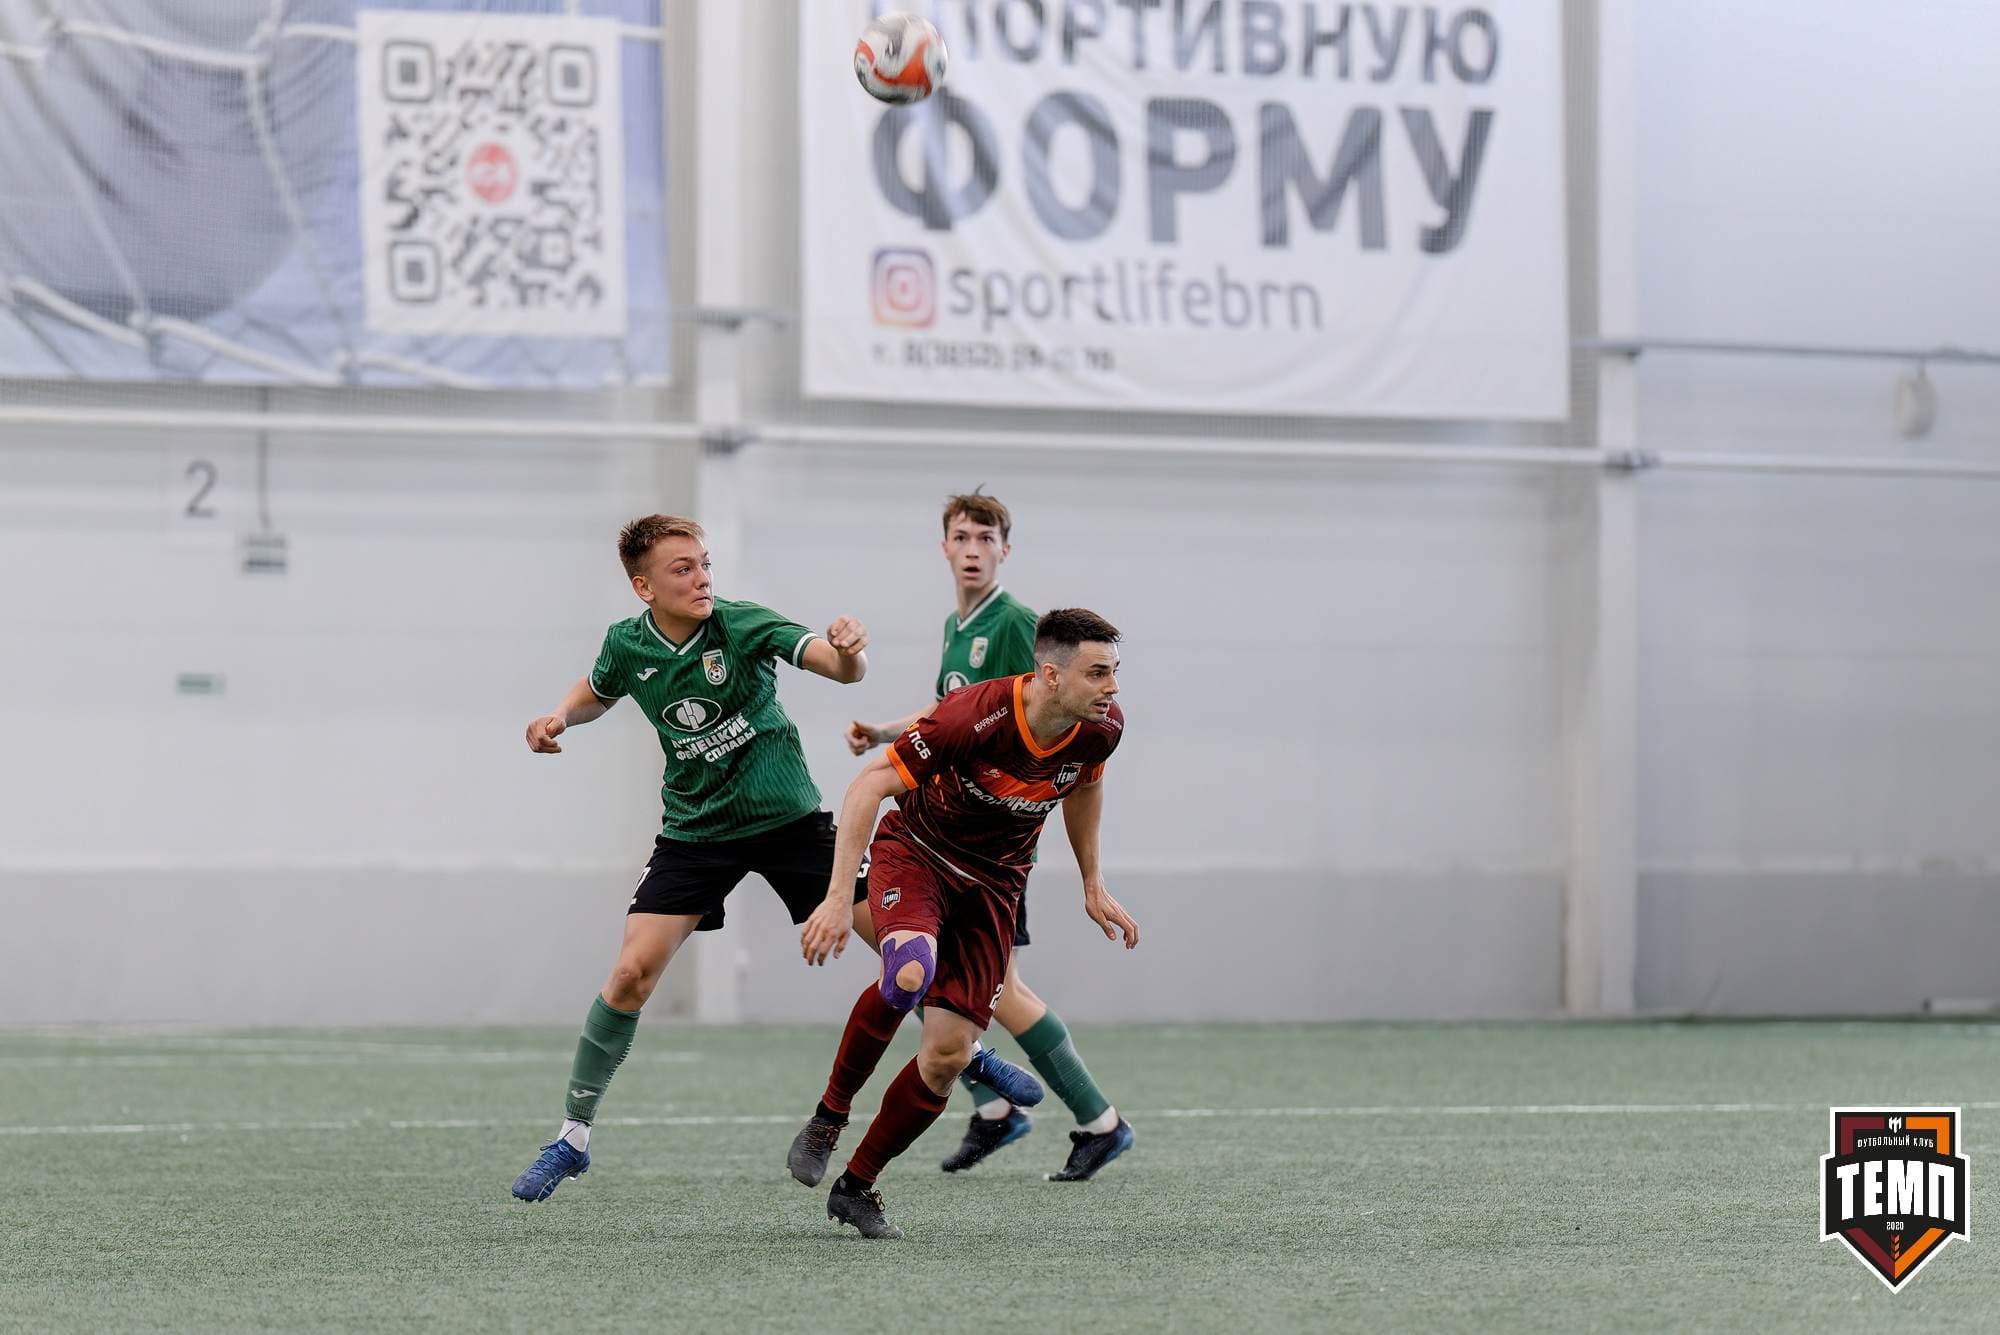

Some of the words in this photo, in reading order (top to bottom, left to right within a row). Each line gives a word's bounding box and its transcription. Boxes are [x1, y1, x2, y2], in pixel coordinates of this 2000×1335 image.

[872, 88, 1495, 255] ФОРМУ
[949, 262, 1324, 332] sportlifebrn
[184, 459, 219, 518] 2
[908, 731, 932, 761] ПСБ
